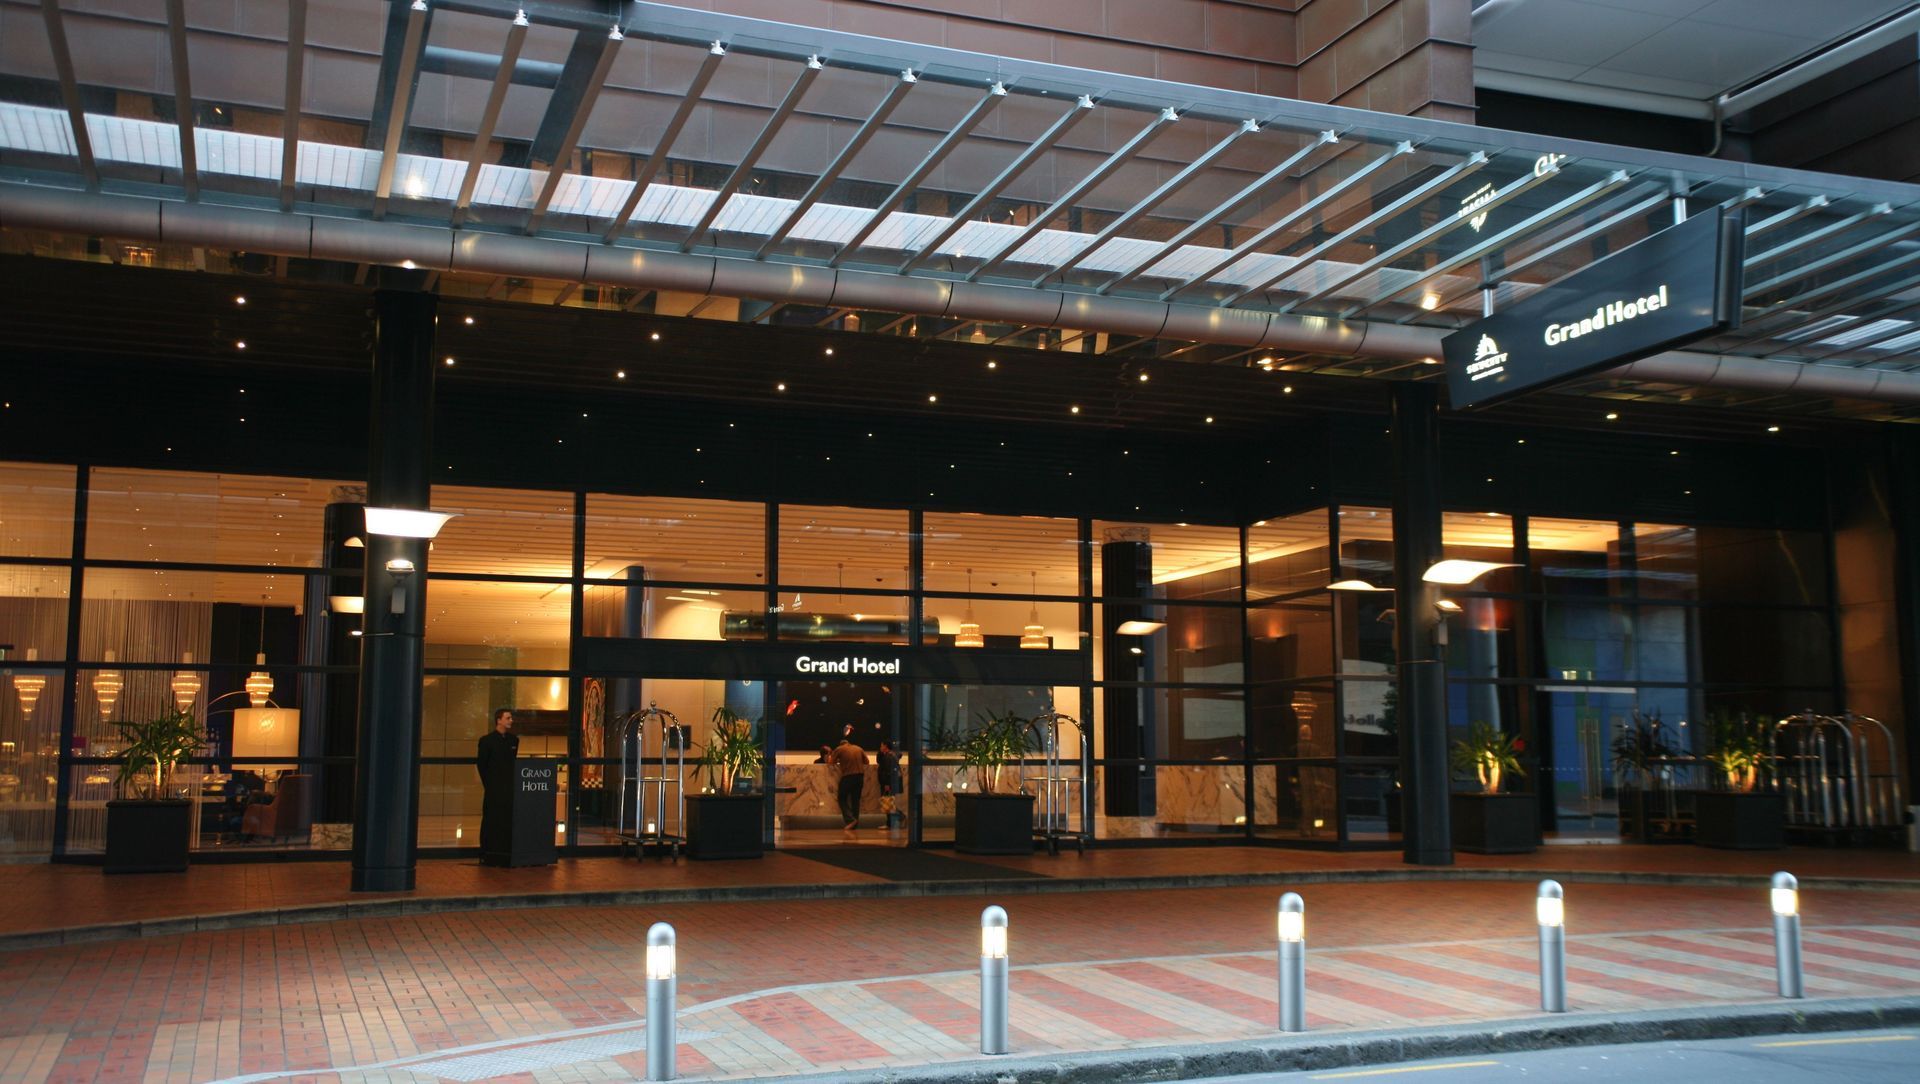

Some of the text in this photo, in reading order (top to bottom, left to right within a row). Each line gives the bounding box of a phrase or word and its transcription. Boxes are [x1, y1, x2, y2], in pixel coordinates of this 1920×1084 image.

[1544, 285, 1668, 346] Grand Hotel
[796, 656, 900, 674] Grand Hotel
[521, 767, 552, 778] GRAND
[522, 781, 550, 792] HOTEL
